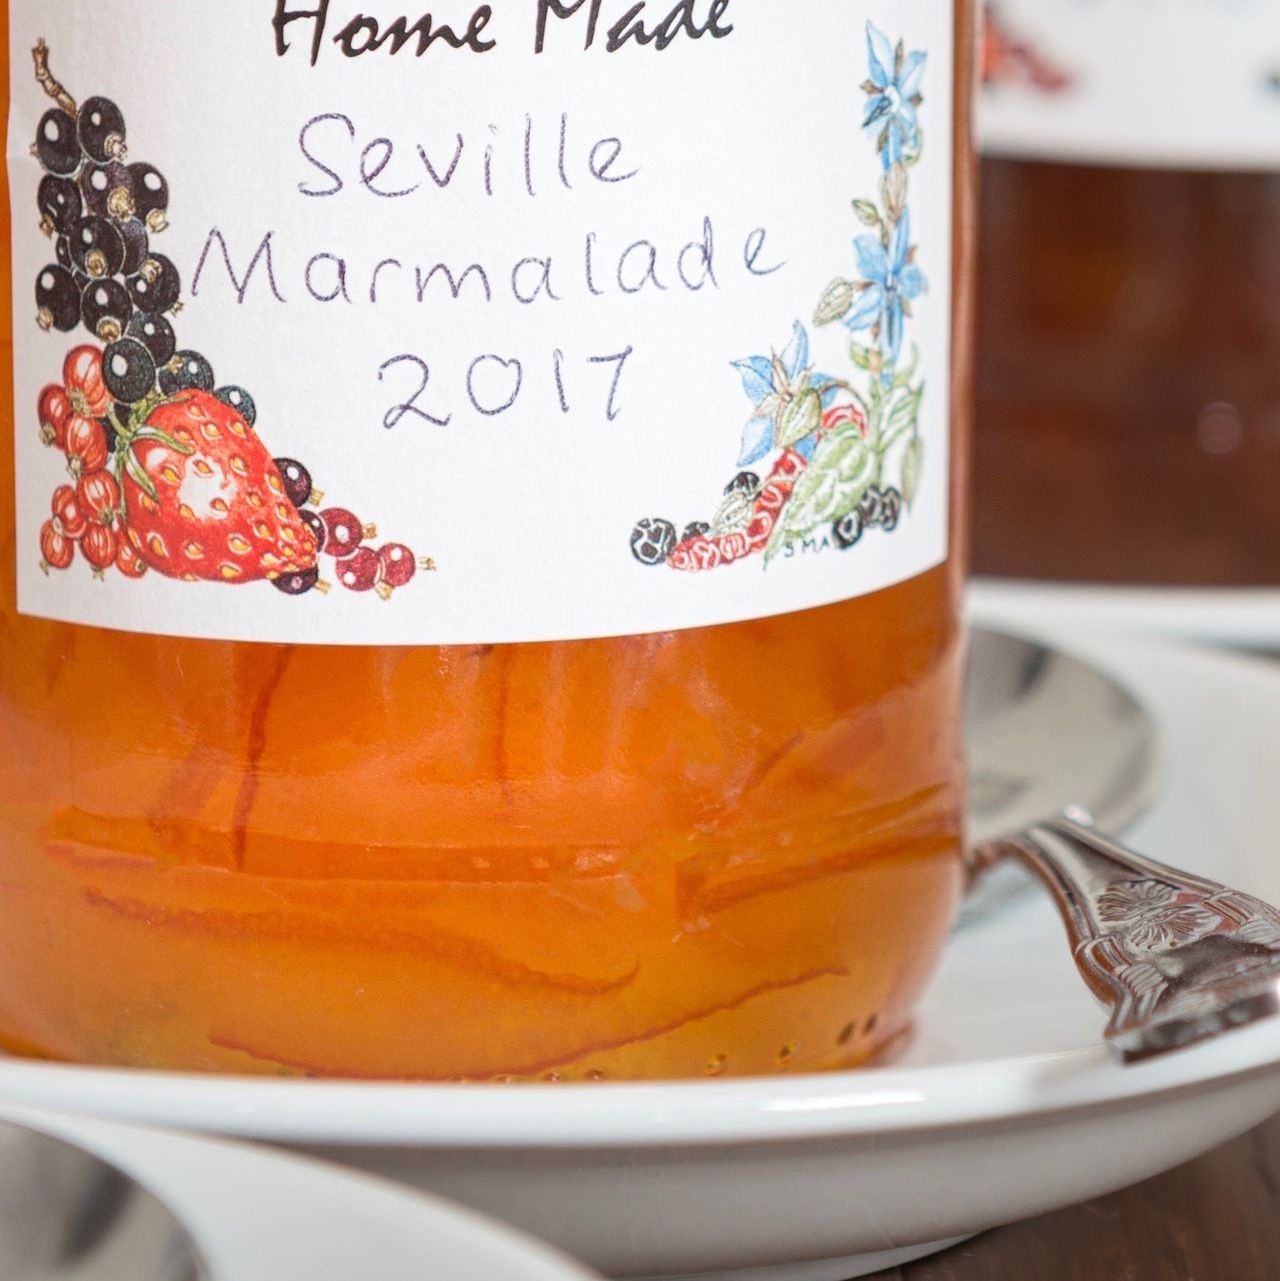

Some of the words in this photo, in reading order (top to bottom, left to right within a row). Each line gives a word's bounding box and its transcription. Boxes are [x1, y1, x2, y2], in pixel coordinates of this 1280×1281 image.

[297, 112, 643, 199] Seville
[190, 215, 789, 306] Marmalade
[376, 344, 634, 430] 2017
